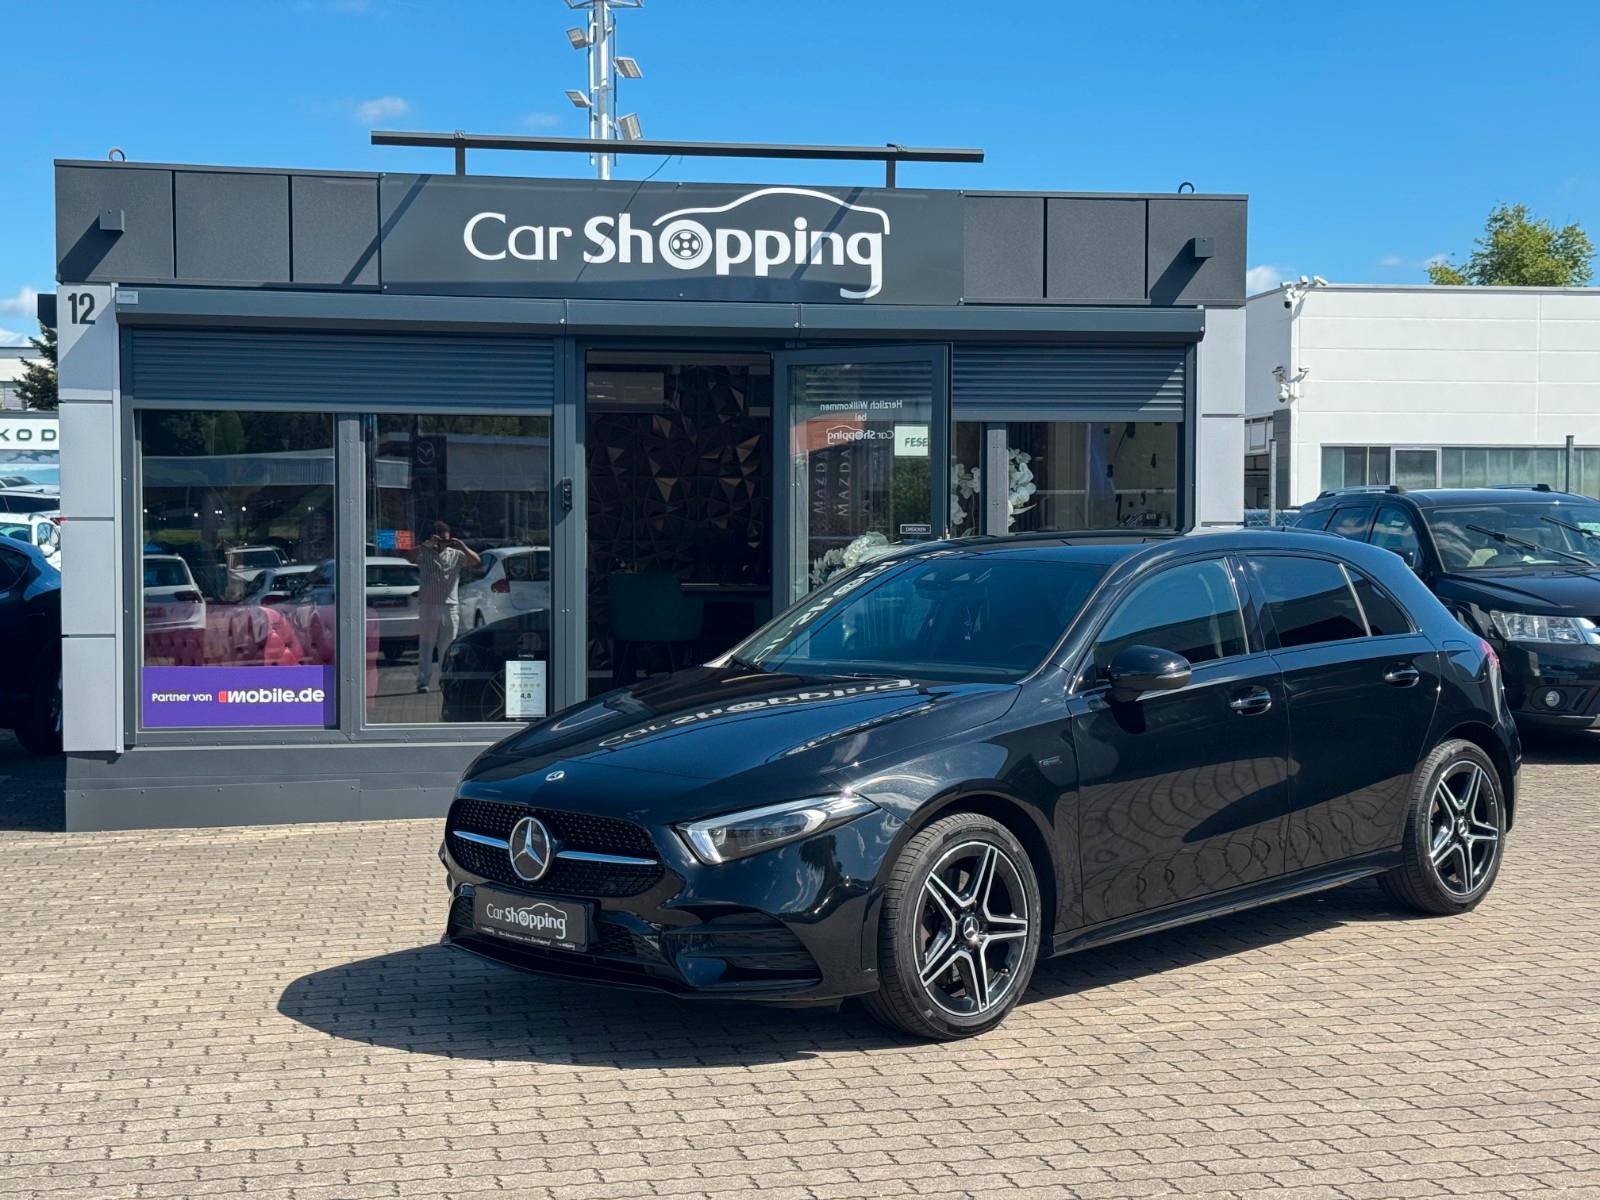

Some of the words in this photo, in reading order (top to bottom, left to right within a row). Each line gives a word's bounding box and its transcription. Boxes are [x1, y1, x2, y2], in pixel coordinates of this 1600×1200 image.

[463, 212, 572, 261] Car
[583, 213, 883, 299] Shopping
[67, 292, 96, 325] 12
[152, 693, 190, 702] Partner
[192, 694, 213, 702] von
[227, 688, 326, 703] mobile.de
[486, 903, 504, 920] Car
[505, 907, 567, 940] Shopping
